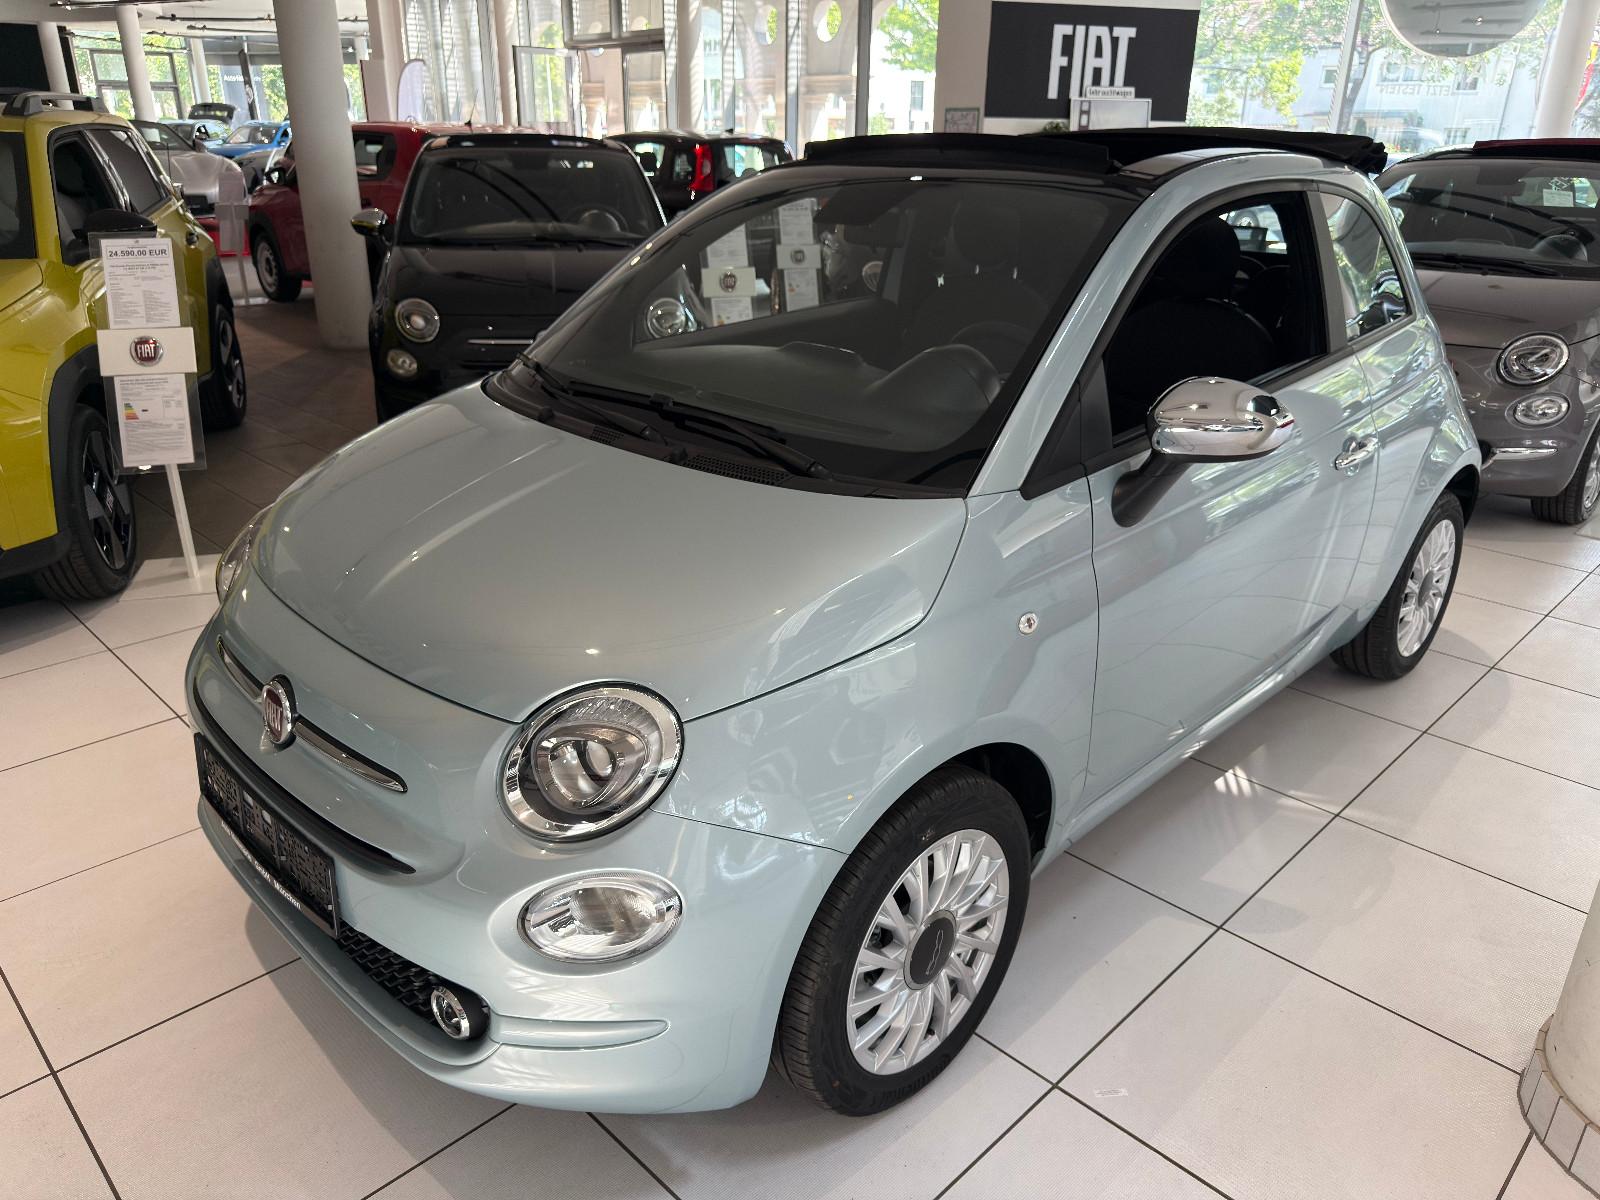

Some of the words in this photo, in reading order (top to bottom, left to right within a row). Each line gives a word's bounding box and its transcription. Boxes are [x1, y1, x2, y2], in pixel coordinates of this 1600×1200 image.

[1047, 23, 1137, 99] FIAT
[149, 248, 168, 256] EUR
[137, 343, 156, 358] FIAT
